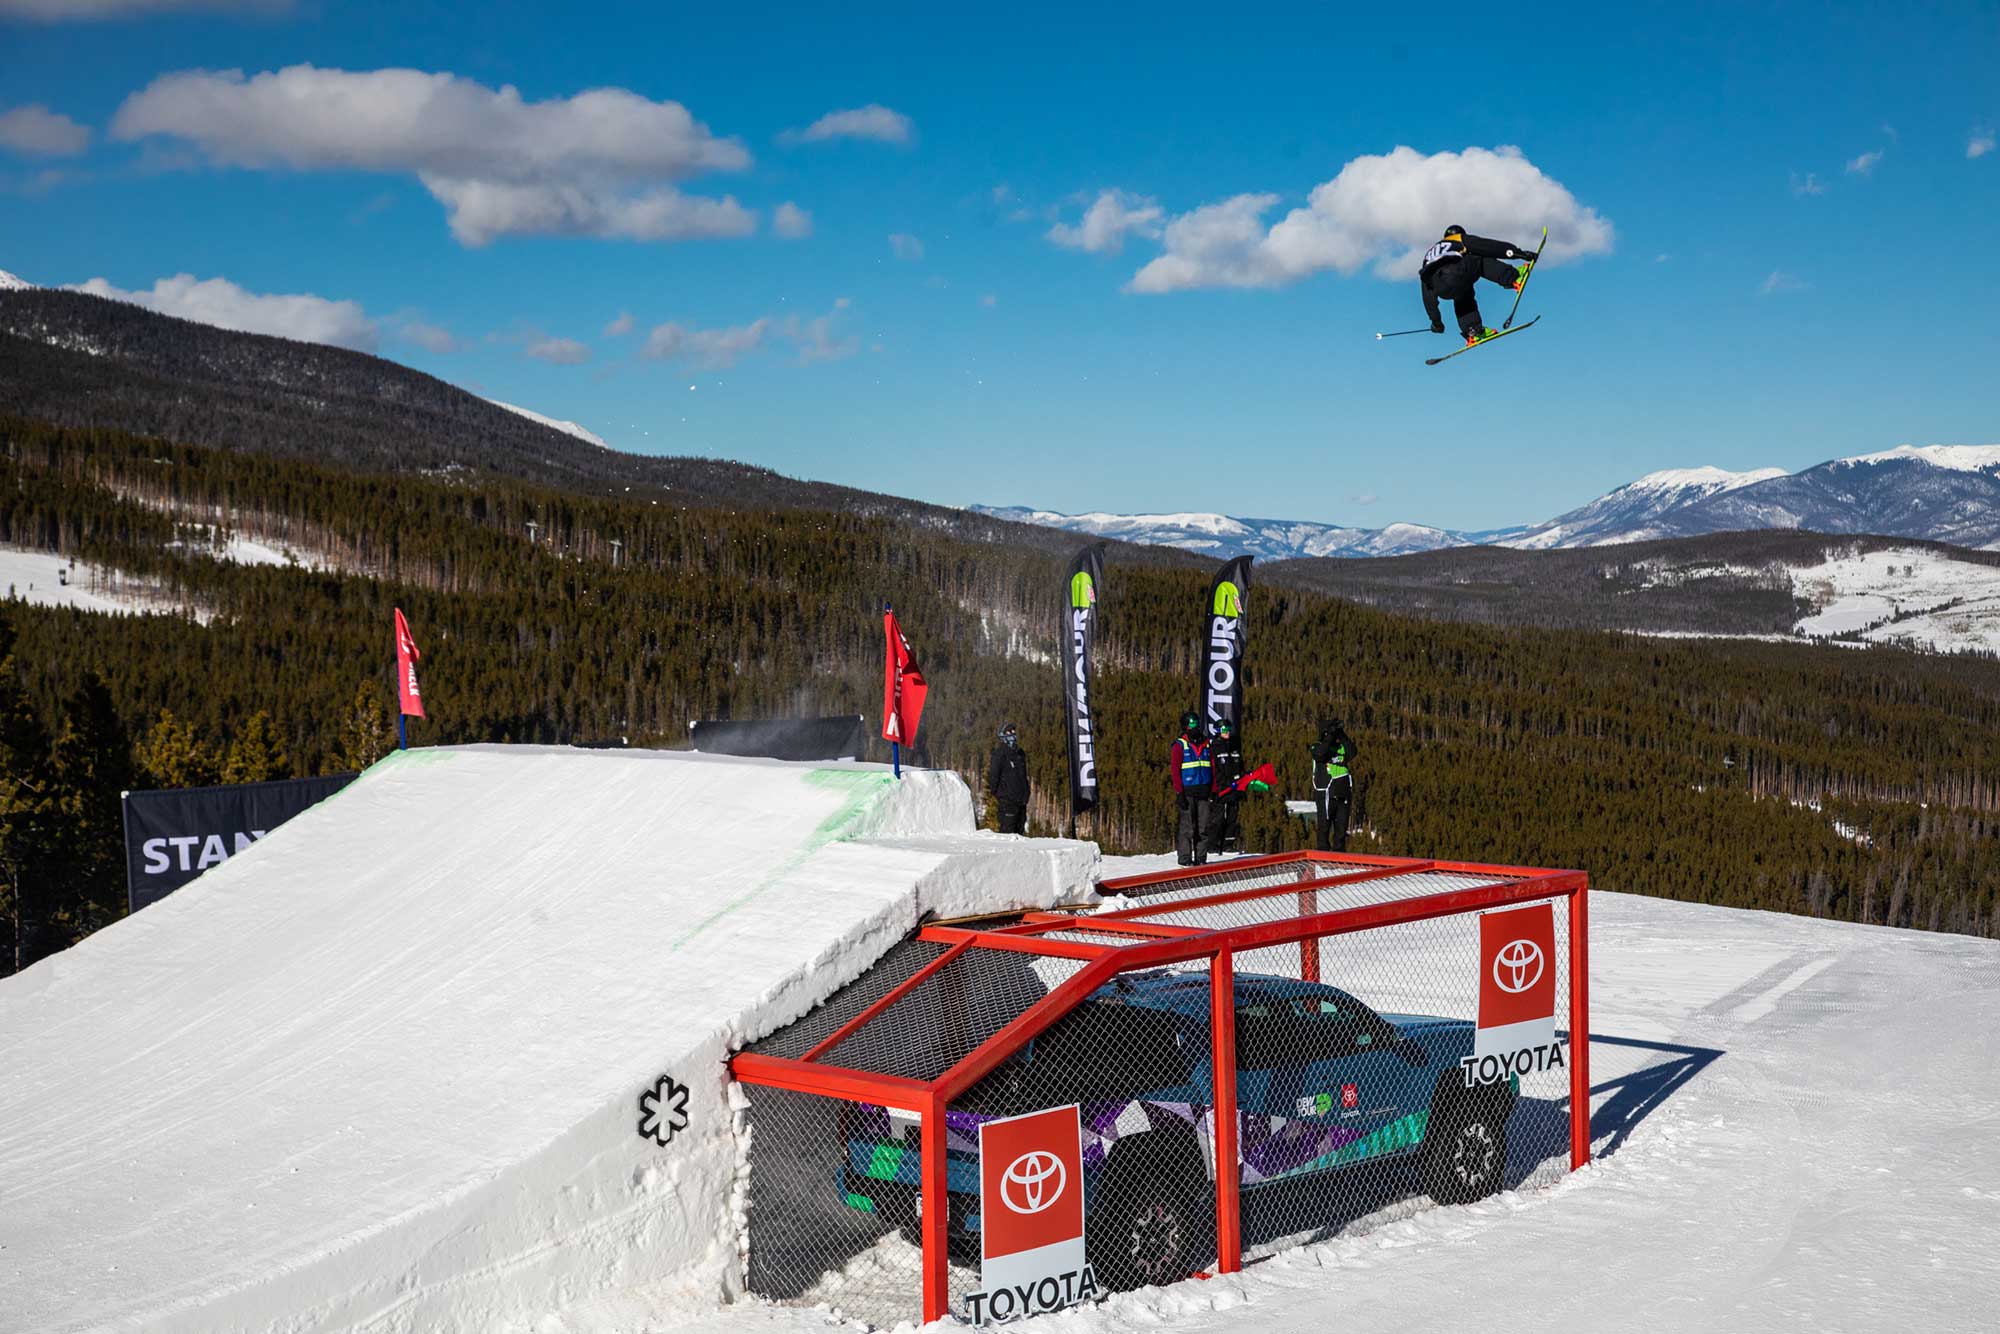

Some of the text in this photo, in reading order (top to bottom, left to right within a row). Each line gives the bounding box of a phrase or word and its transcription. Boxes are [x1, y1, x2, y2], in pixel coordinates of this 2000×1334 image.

[1462, 1042, 1565, 1087] TOYOTA
[1296, 1095, 1315, 1108] DEW
[1297, 1106, 1317, 1117] TOUR
[1340, 1110, 1360, 1118] TOYOTA
[965, 1266, 1099, 1325] TOYOTA
